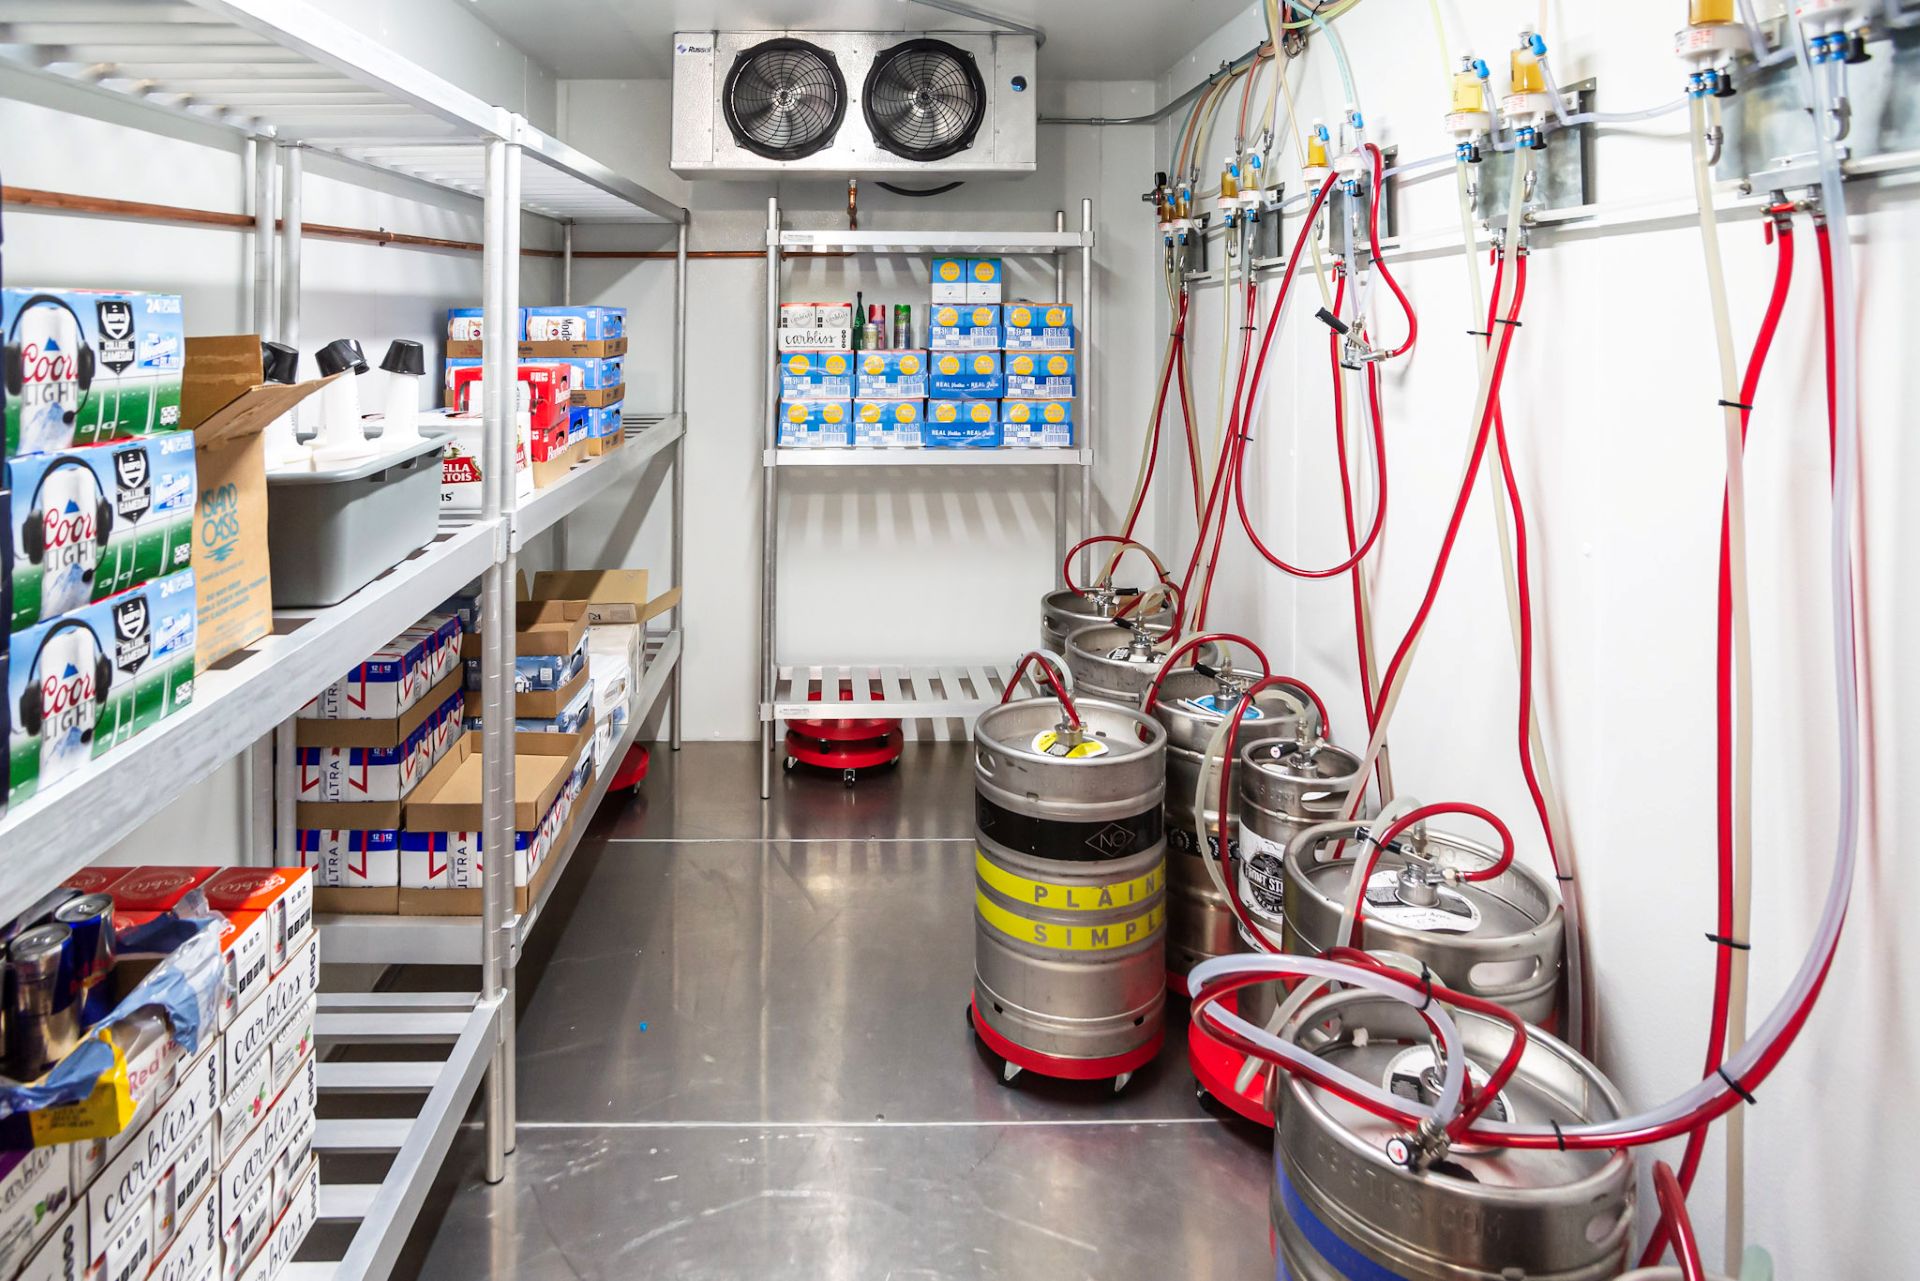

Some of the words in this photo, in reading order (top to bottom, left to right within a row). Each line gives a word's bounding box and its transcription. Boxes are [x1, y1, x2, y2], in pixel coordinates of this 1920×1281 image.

[785, 330, 835, 345] carbliss
[442, 463, 471, 473] ELLA
[442, 472, 472, 482] TOIS
[42, 508, 97, 551] Coor
[40, 674, 96, 720] Coor
[1099, 831, 1127, 849] NO
[1034, 877, 1155, 909] PLAIN
[1033, 913, 1156, 947] SIMPL
[234, 970, 305, 1065] carbliss
[103, 1089, 201, 1224] carbliss
[233, 1092, 304, 1200] carbliss
